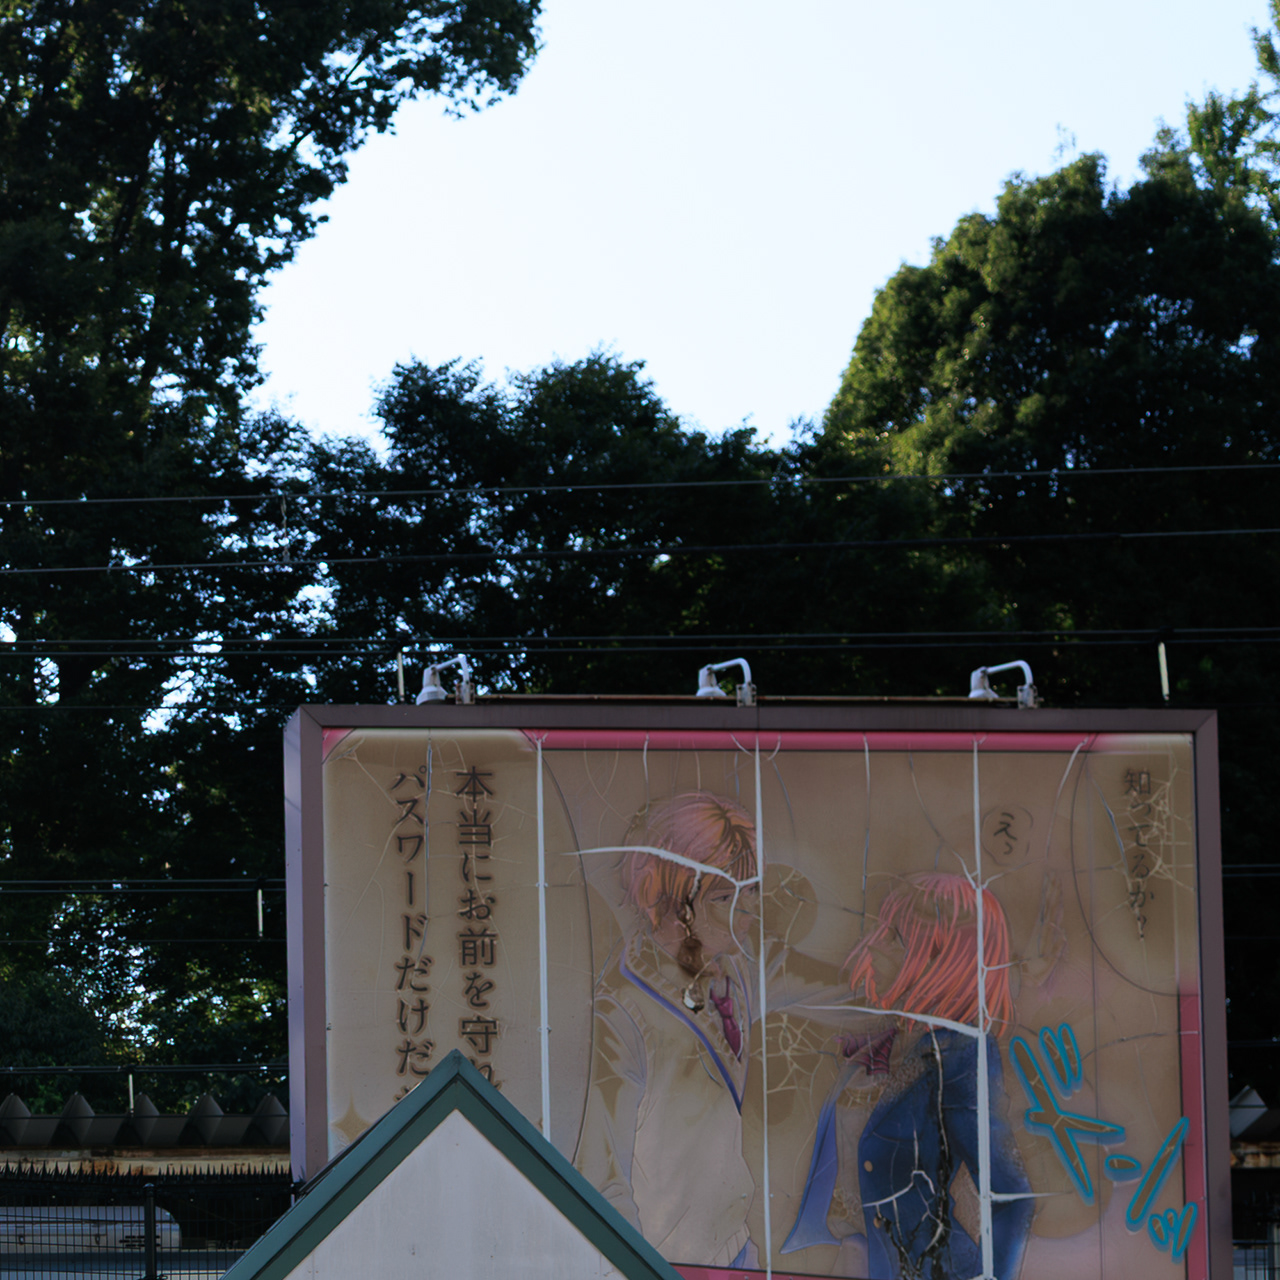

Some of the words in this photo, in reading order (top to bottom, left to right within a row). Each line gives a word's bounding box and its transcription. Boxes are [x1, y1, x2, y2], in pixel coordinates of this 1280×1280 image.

[391, 765, 433, 1101] パスワードだけだ
